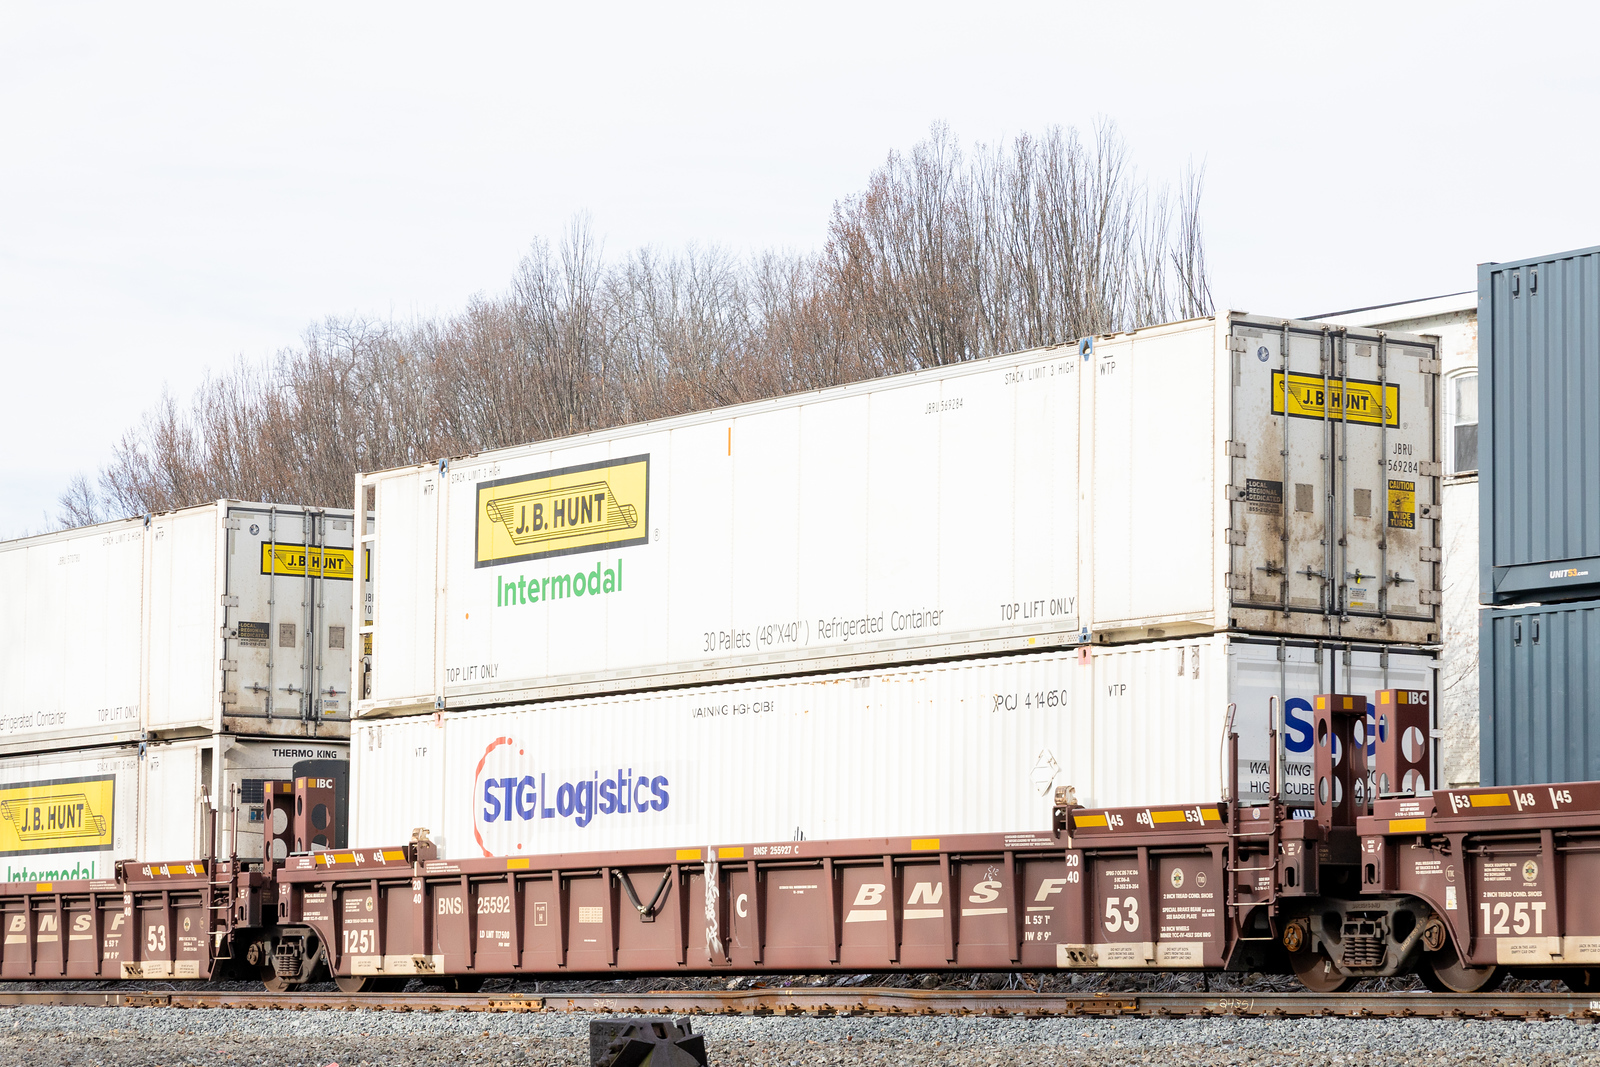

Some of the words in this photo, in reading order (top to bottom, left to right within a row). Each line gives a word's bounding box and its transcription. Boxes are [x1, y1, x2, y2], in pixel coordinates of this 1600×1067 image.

[1005, 370, 1024, 385] STACK
[1028, 366, 1046, 380] LIMIT
[1050, 365, 1054, 376] 3
[1058, 361, 1074, 375] HIGH
[1100, 361, 1116, 376] WTP
[1331, 392, 1369, 411] HUNT
[1393, 443, 1412, 456] JBRU
[1388, 460, 1418, 473] 569284
[451, 473, 465, 484] STACK
[468, 469, 481, 481] LIMIT
[483, 468, 487, 478] 3
[489, 465, 501, 477] HIGH
[424, 484, 434, 496] WTP
[1248, 481, 1268, 489] LOCAL
[1389, 480, 1414, 491] CAUTION
[1248, 488, 1278, 496] REGIONAL
[1248, 494, 1281, 502] DEDICATED
[553, 492, 606, 528] HUNT
[1392, 511, 1411, 520] WIDE
[1390, 518, 1414, 528] TURNS
[312, 556, 344, 569] HUNT
[1549, 568, 1589, 579] UNIT53.com
[497, 558, 623, 608] Intermodal
[1001, 603, 1020, 621] TOP
[1024, 600, 1045, 618] LIFT
[1050, 597, 1075, 616] ONLY
[703, 631, 716, 652] 30
[719, 628, 751, 650] Pallets
[818, 611, 884, 641] Refrigerated
[891, 606, 944, 631] Container
[446, 667, 460, 682] TOP
[462, 666, 478, 680] LIFT
[480, 663, 499, 678] ONLY
[1408, 691, 1427, 705] IBC
[36, 710, 67, 727] Container
[98, 708, 109, 722] TOP
[110, 707, 123, 721] LIFT
[125, 704, 139, 719] ONLY
[272, 748, 314, 758] THERMO
[317, 750, 337, 758] KING
[97, 762, 108, 772] STACK
[1250, 761, 1311, 777] WANING
[317, 778, 333, 788] IBC
[1250, 781, 1270, 794] HIG
[1455, 794, 1470, 808] 53
[1520, 793, 1535, 806] 48
[1556, 790, 1572, 804] 45
[48, 803, 84, 830] HUNT
[1111, 814, 1124, 827] 45
[1136, 812, 1149, 825] 48
[1185, 810, 1199, 822] 53
[753, 846, 768, 856] BNSF
[770, 845, 792, 855] 255927
[794, 845, 799, 854] C
[327, 855, 336, 864] 53
[356, 853, 365, 863] 48
[373, 852, 382, 863] 45
[1066, 854, 1079, 867] 20
[185, 865, 194, 875] 53
[1066, 870, 1079, 883] 40
[412, 880, 421, 891] 20
[124, 894, 131, 904] 20
[412, 893, 422, 904] 40
[124, 907, 131, 916] 40
[438, 896, 464, 915] BNS
[736, 893, 748, 918] C
[1025, 915, 1031, 925] IL
[1105, 896, 1139, 932] 53
[1480, 902, 1546, 934] 125T
[147, 925, 166, 952] 53
[1025, 931, 1035, 941] IW
